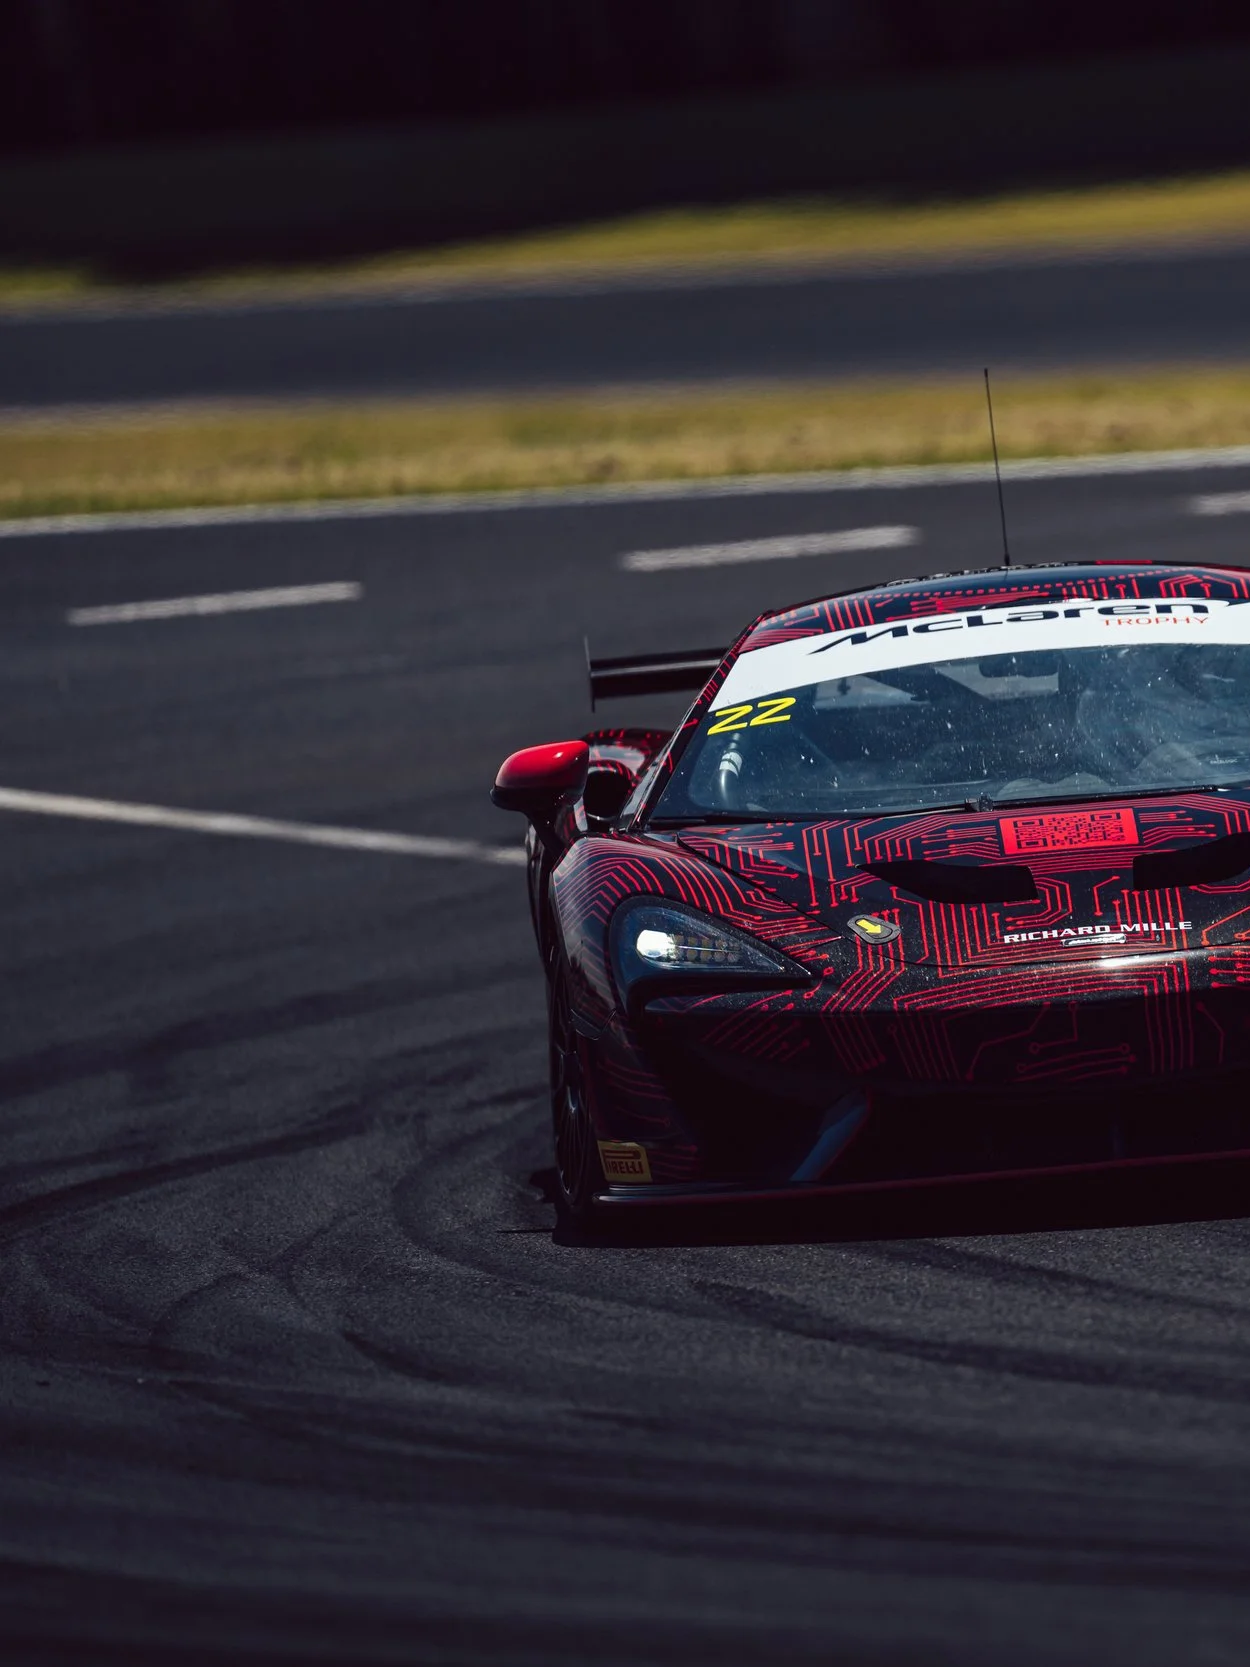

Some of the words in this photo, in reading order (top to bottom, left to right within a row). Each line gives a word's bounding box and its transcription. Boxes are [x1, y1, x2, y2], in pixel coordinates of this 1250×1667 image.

[807, 603, 1210, 655] McLaren
[1101, 616, 1209, 626] TROPHY
[707, 697, 796, 735] 22
[1004, 925, 1110, 944] RICHARD
[1120, 921, 1193, 932] MILLE
[601, 1149, 645, 1175] PIRELLI
